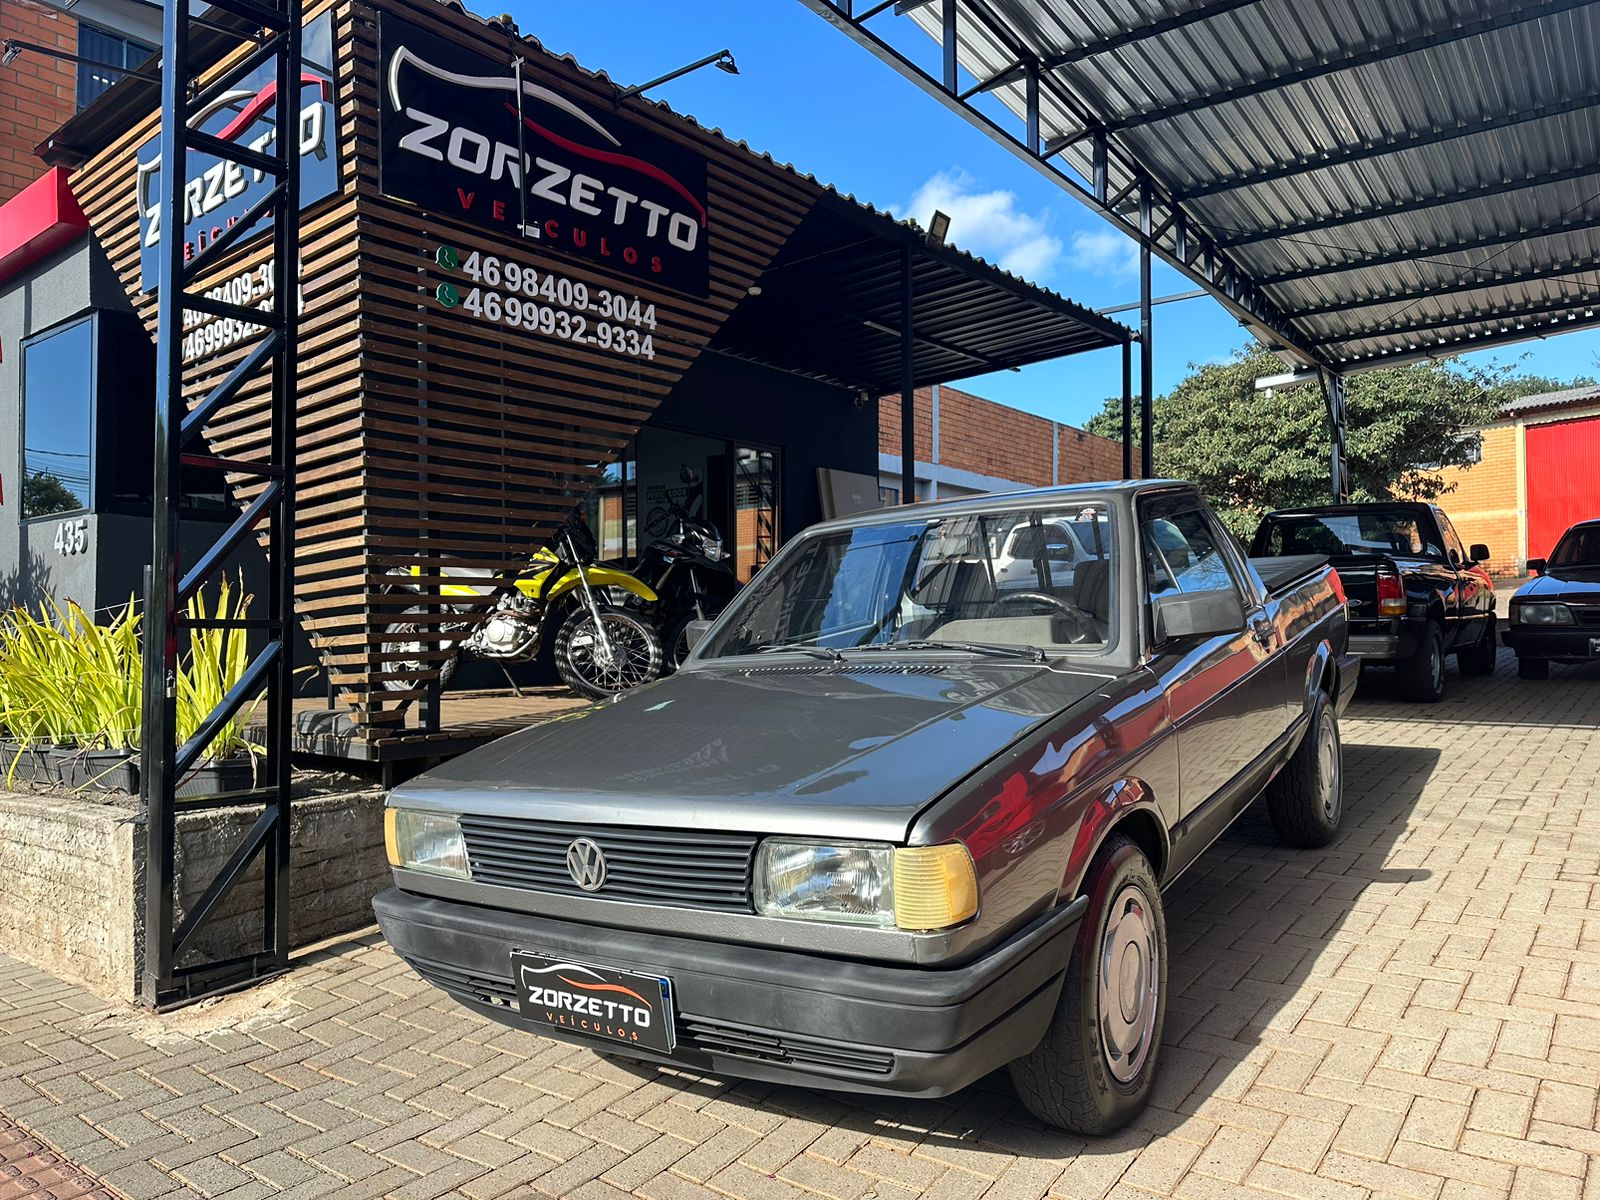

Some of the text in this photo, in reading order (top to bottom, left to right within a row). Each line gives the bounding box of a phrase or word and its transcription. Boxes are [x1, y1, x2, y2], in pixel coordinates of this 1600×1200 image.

[399, 107, 698, 251] ZORZETTO
[457, 188, 662, 272] VECULOS
[463, 251, 657, 330] 46 98409-3044
[463, 288, 655, 360] 46 99932-9334
[54, 519, 86, 555] 435
[528, 985, 650, 1028] ZORZETTO
[546, 1012, 638, 1041] VEÍCULOS
